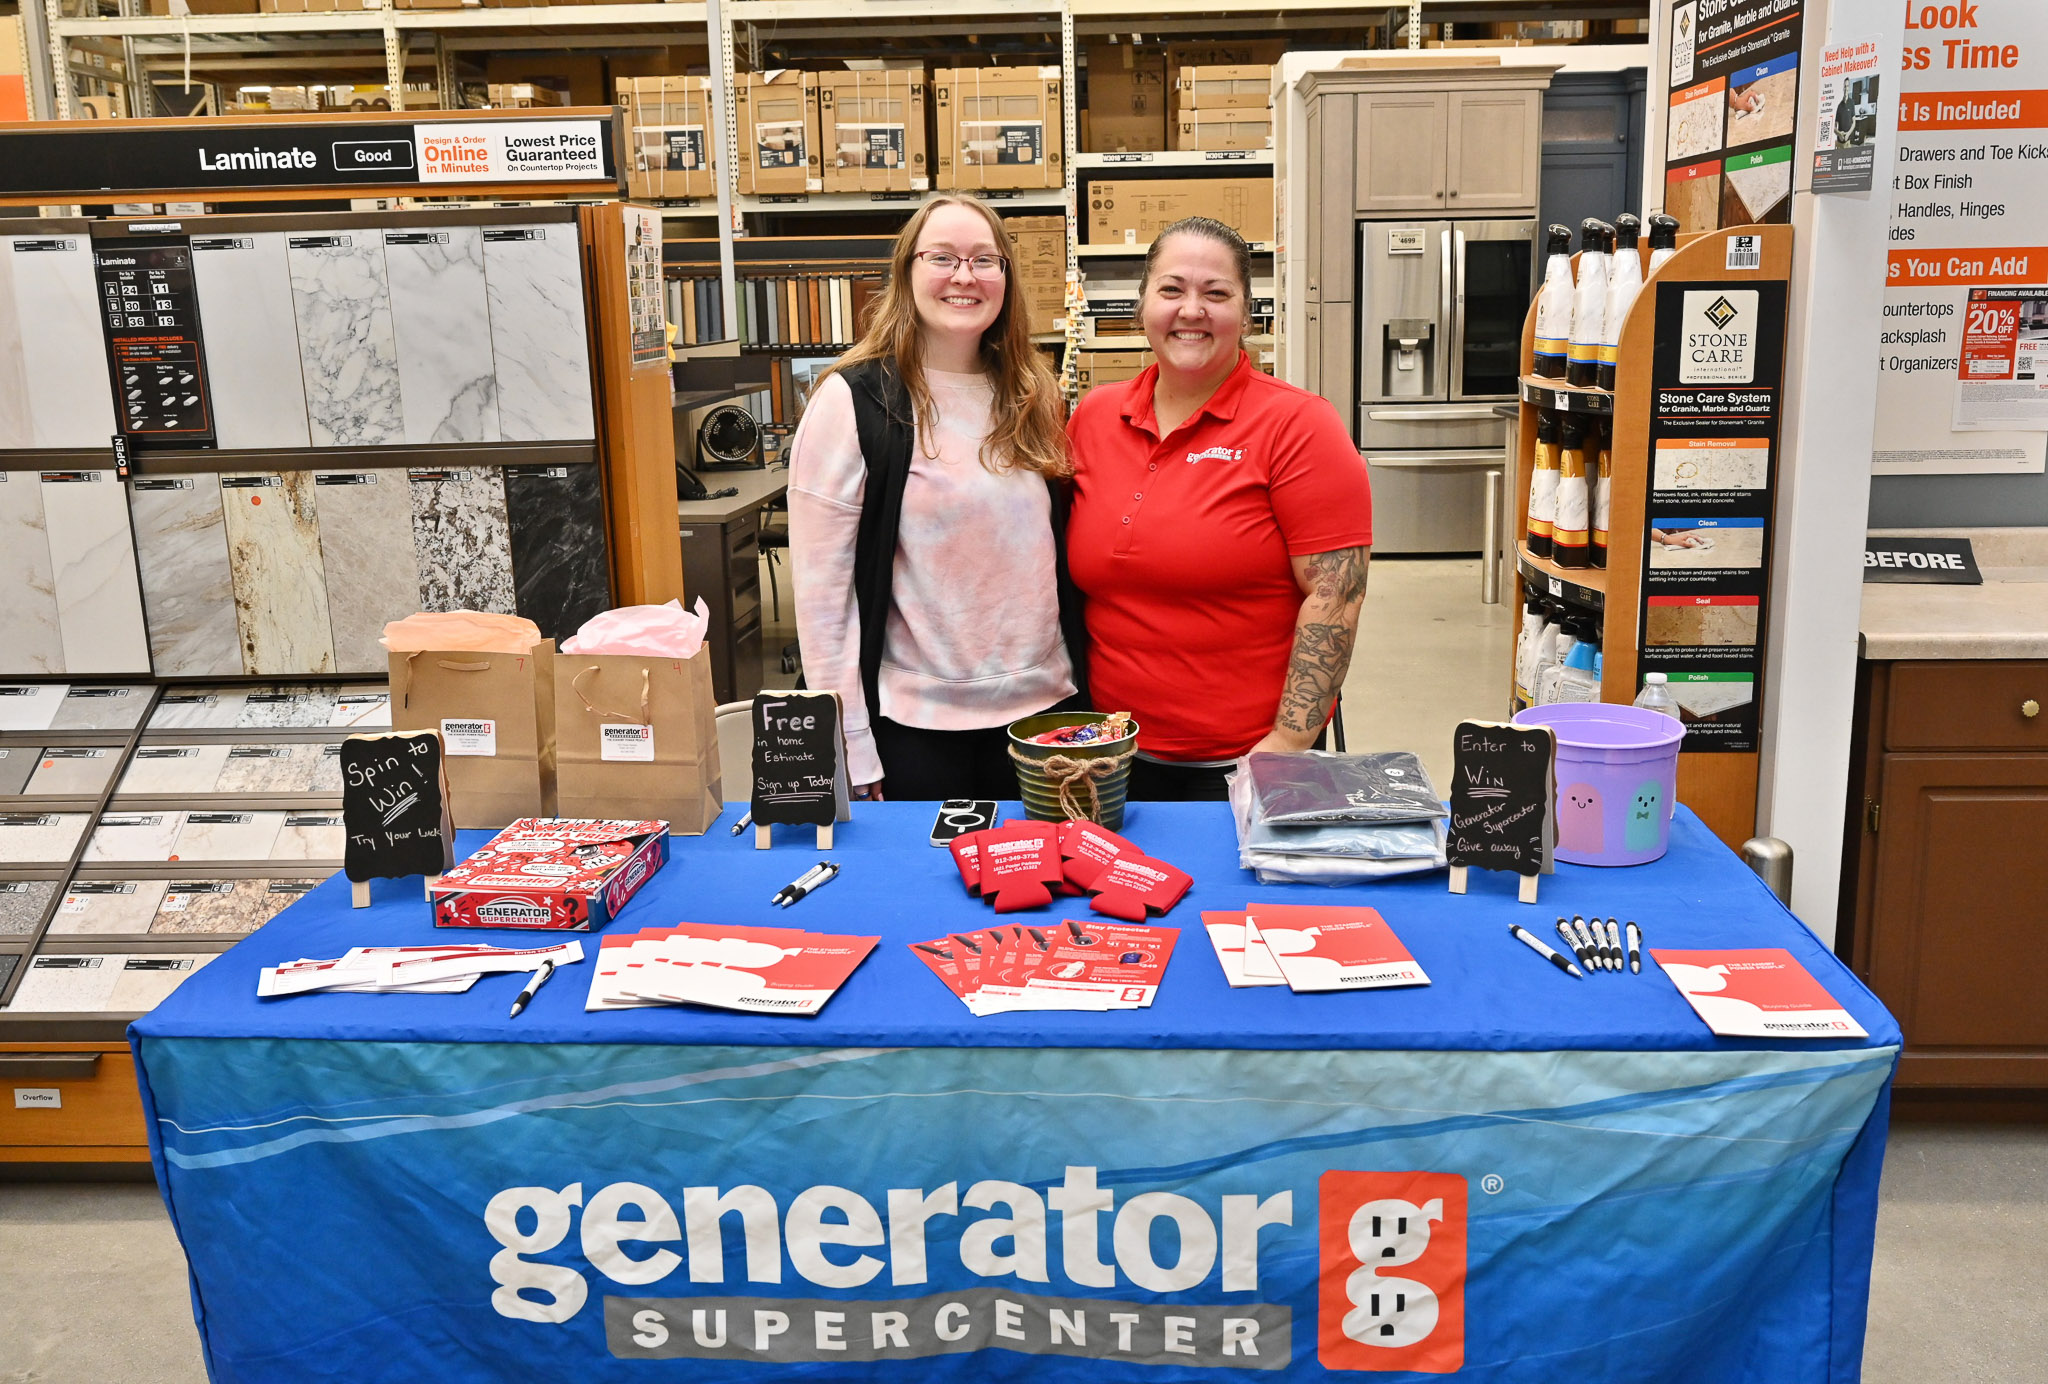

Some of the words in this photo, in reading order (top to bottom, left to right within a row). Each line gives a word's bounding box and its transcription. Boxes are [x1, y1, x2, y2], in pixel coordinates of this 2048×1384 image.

[1699, 0, 1728, 21] Stone
[1905, 0, 1979, 29] Look
[1698, 30, 1708, 44] for
[1708, 20, 1733, 40] Granite,
[1733, 8, 1757, 30] Marble
[1758, 1, 1772, 20] and
[1674, 38, 1693, 56] STONE
[1709, 52, 1727, 66] Exclusive
[1727, 48, 1740, 60] Sealer
[1773, 28, 1791, 43] Granite
[1825, 49, 1839, 63] Need
[1840, 46, 1854, 60] Help
[1855, 42, 1869, 56] with
[1870, 43, 1875, 53] a
[1942, 39, 2019, 69] Time
[1674, 52, 1692, 69] CARE
[1821, 62, 1843, 78] Cabinet
[1844, 55, 1878, 73] Makeover?
[1755, 66, 1769, 77] Clean
[1693, 86, 1709, 97] Removal
[1913, 101, 1931, 122] Is
[1936, 100, 2021, 121] Included
[423, 137, 452, 146] Design
[454, 136, 461, 144] &
[462, 136, 486, 145] Order
[504, 135, 555, 148] Lowest
[559, 134, 596, 147] Price
[199, 147, 317, 171] Laminate
[354, 149, 392, 163] Good
[424, 145, 488, 162] Online
[506, 148, 597, 162] Guaranteed
[1750, 154, 1764, 165] Polish
[1900, 147, 1956, 162] Drawers
[1960, 145, 1985, 161] and
[1990, 145, 2013, 160] Toe
[2018, 144, 2048, 159] Kicks
[426, 164, 437, 174] in
[440, 163, 490, 174] Minutes
[507, 164, 519, 172] On
[519, 163, 564, 173] Countertop
[565, 162, 598, 172] Projects
[1688, 167, 1697, 177] Seal
[1904, 175, 1930, 190] Box
[1934, 174, 1973, 189] Finish
[1898, 203, 1955, 219] Handles,
[1960, 202, 2005, 219] Hinges
[100, 257, 136, 266] Laminate
[1906, 258, 1941, 278] You
[1947, 257, 1983, 277] Can
[1989, 256, 2028, 276] Add
[123, 287, 137, 295] 24
[154, 285, 168, 293] 11
[126, 302, 139, 310] 30
[157, 301, 171, 309] 13
[129, 318, 144, 326] 36
[160, 317, 174, 326] 19
[1967, 308, 2015, 334] 20%
[1998, 325, 2014, 334] OFF
[1689, 333, 1748, 347] STONE
[2019, 343, 2038, 351] FREE
[1691, 349, 1743, 363] CARE
[1889, 356, 1958, 374] Organizers
[1659, 393, 1693, 404] Stone
[1696, 392, 1725, 403] Care
[1727, 392, 1771, 405] System
[115, 438, 127, 467] OPEN
[1864, 551, 1966, 570] BEFORE
[515, 657, 525, 672] 7
[673, 661, 682, 675] 4
[763, 701, 816, 731] Free
[445, 723, 483, 732] generator
[604, 728, 641, 737] generator
[757, 736, 768, 747] in
[777, 736, 804, 746] home
[1461, 734, 1507, 752] Enter
[1520, 740, 1536, 752] to
[347, 757, 400, 787] Spin
[408, 742, 429, 756] to
[757, 776, 783, 795] Sign
[787, 780, 800, 794] up
[802, 774, 834, 790] Today
[1453, 802, 1507, 829] Generator
[1483, 803, 1537, 834] Supercenter
[534, 823, 632, 835] WHEEL
[350, 834, 376, 851] Try
[418, 828, 442, 838] Luck
[987, 839, 1034, 853] generator
[1456, 837, 1484, 852] Give
[1490, 843, 1521, 860] away
[994, 853, 1039, 864] 912-349-3736
[477, 907, 551, 917] GENERATOR
[481, 916, 546, 924] SUPERCENTER
[1085, 923, 1106, 931] Stay
[1106, 925, 1151, 933] Protected
[1339, 972, 1400, 983] generator
[738, 996, 800, 1007] generator
[1763, 1021, 1831, 1031] generator
[483, 1165, 1295, 1325] generator
[631, 1297, 1262, 1359] SUPERCENTER
